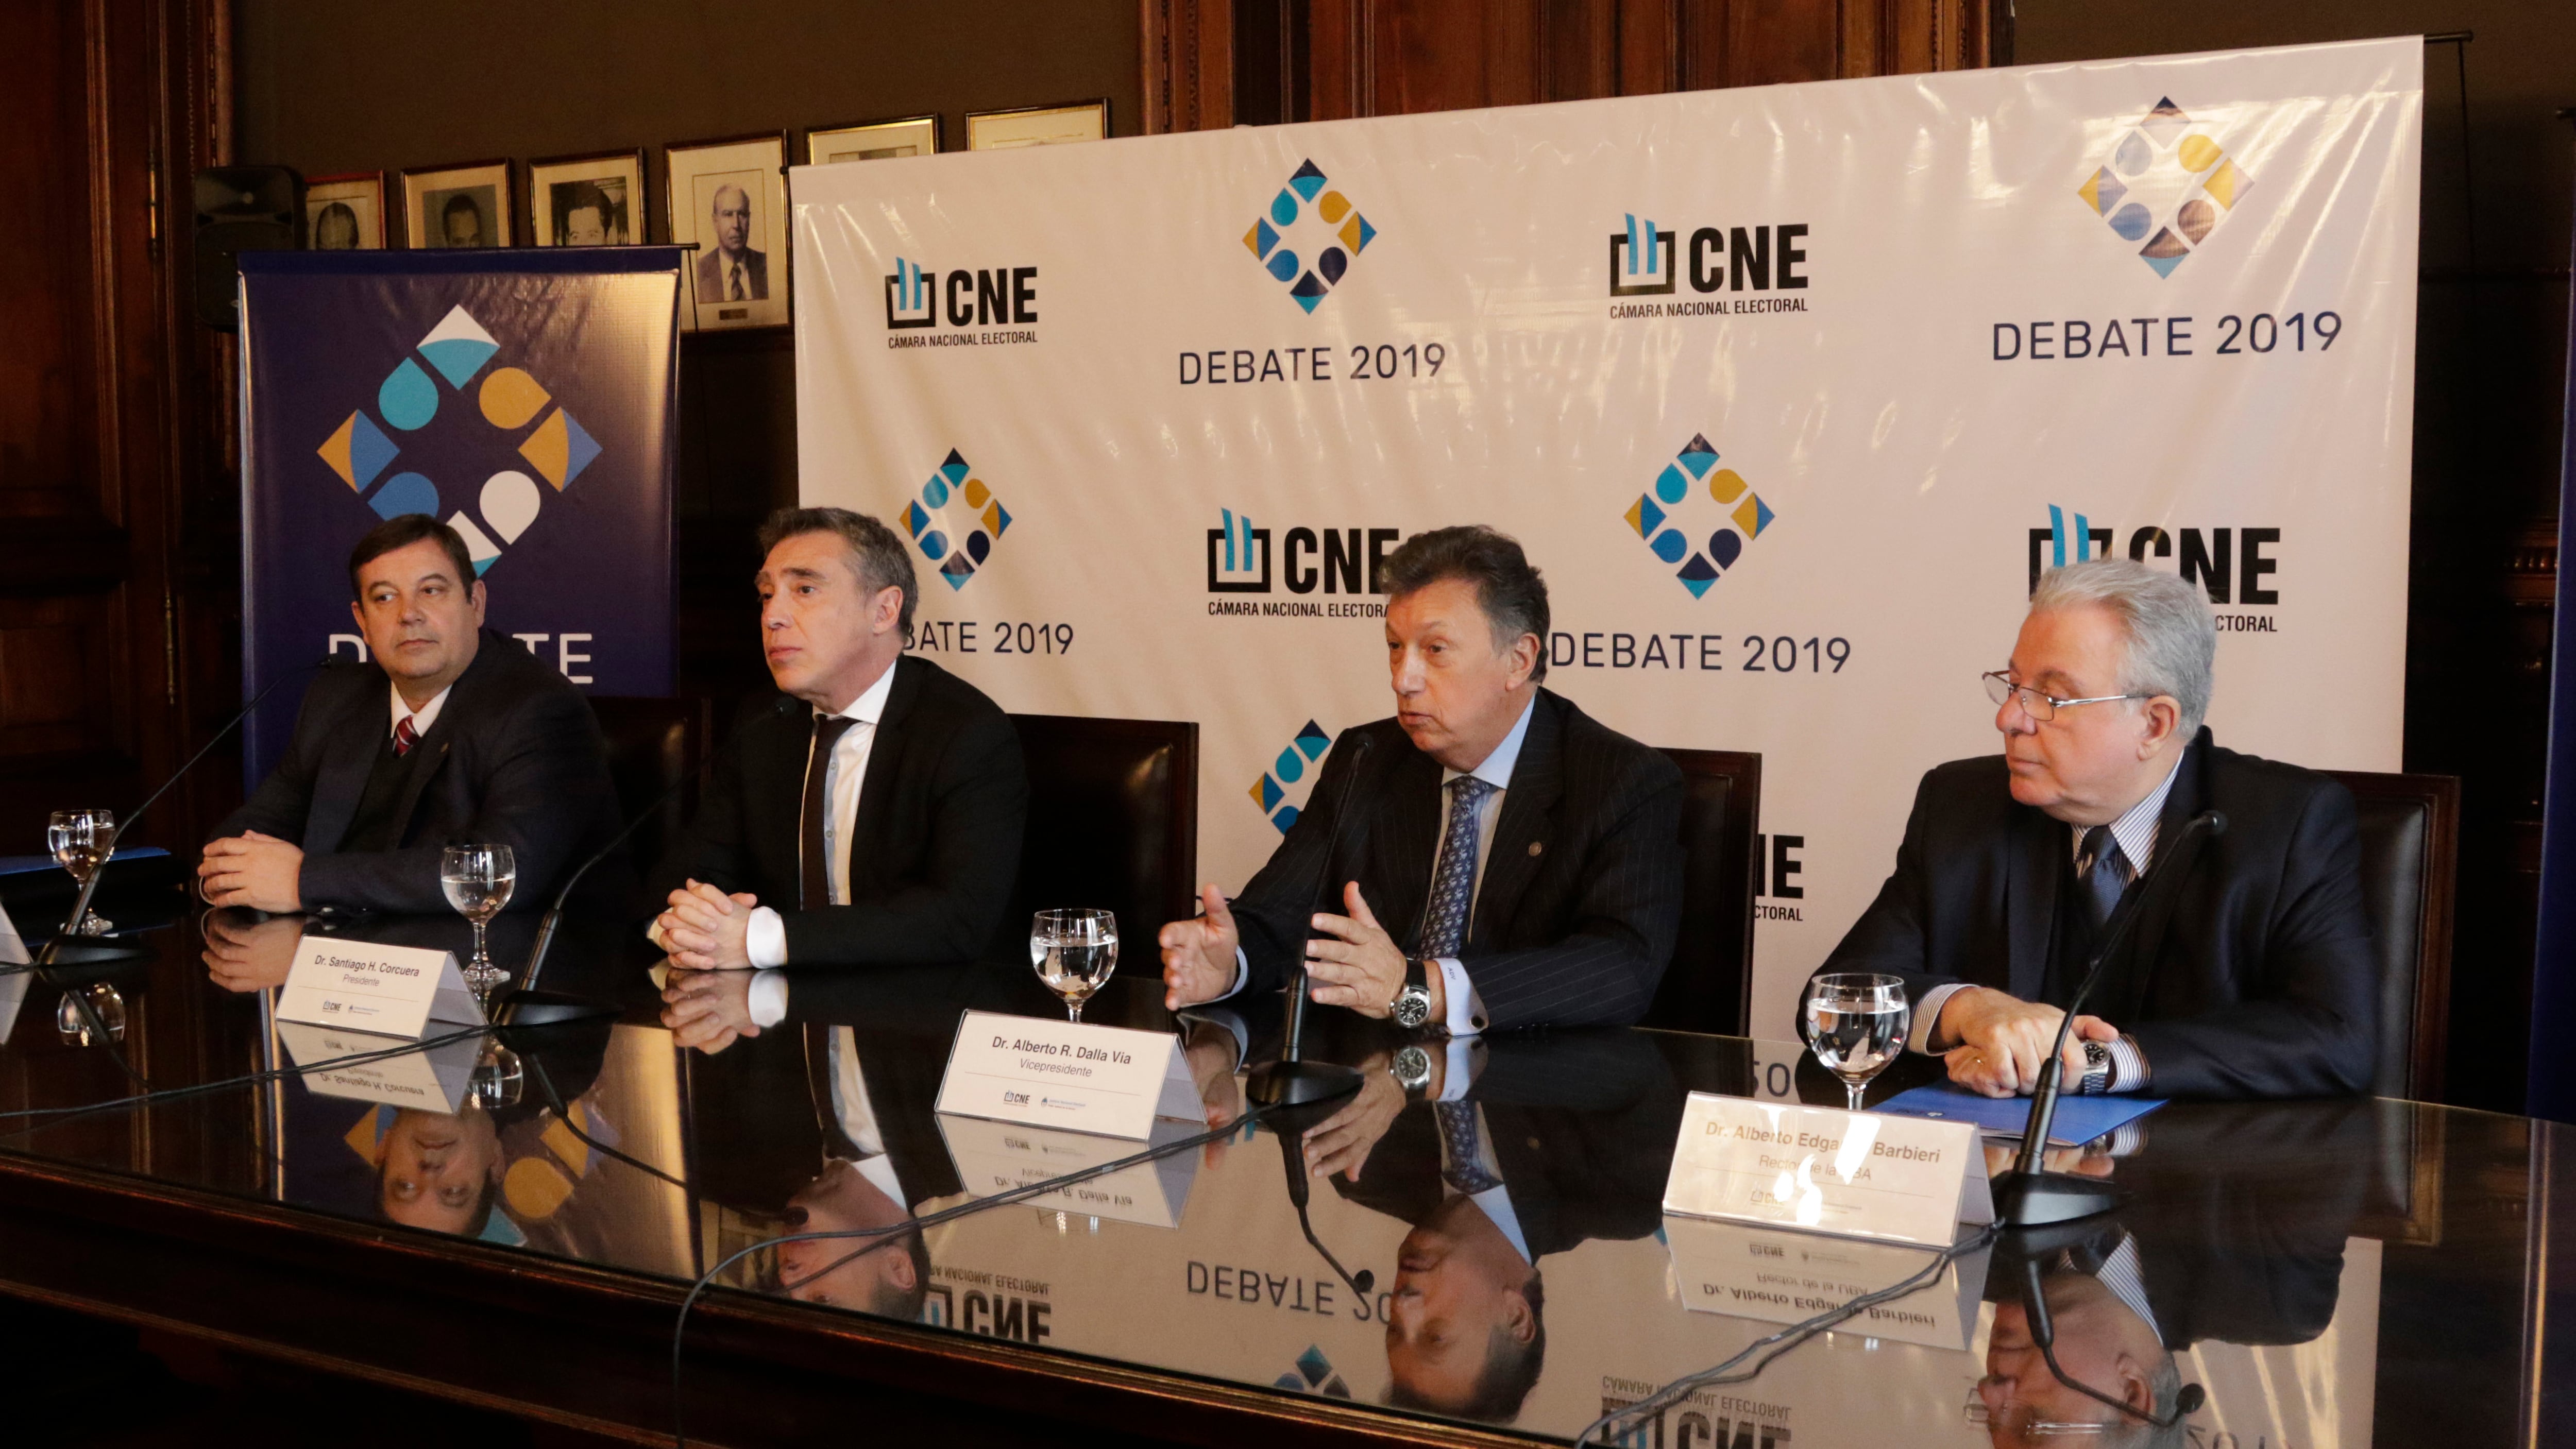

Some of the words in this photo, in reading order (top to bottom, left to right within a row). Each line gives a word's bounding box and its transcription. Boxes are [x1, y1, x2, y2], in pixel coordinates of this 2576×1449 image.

[1690, 224, 1808, 293] CNE
[946, 267, 1038, 327] CNE
[1611, 302, 1663, 319] CÁMARA
[1667, 301, 1730, 316] NACIONAL
[1735, 298, 1808, 314] ELECTORAL
[888, 334, 926, 349] CÁMARA
[929, 334, 978, 347] NACIONAL
[981, 331, 1038, 345] ELECTORAL
[1993, 316, 2193, 360] DEBATE
[2216, 311, 2342, 354] 2019
[1180, 347, 1332, 384] DEBATE
[1350, 343, 1446, 379] 2019
[1284, 526, 1399, 594] CNE
[1208, 599, 1259, 616] CÁMARA
[1263, 602, 1324, 617] NACIONAL
[1328, 603, 1389, 618] ELECTOR
[2215, 615, 2278, 632] CTORAL
[903, 621, 977, 653] BATE
[994, 622, 1074, 654] 2019
[1551, 632, 1722, 670] DEBATE
[1743, 635, 1851, 673] 2019
[1755, 905, 1803, 921] CTORAL
[315, 954, 327, 966] Dr.
[329, 957, 366, 972] Santiago
[368, 961, 377, 971] H.
[379, 962, 420, 977] Corcuera
[342, 974, 380, 987] Presidente
[992, 1036, 1008, 1049] Dr.
[1012, 1038, 1057, 1055] Alberto
[1060, 1045, 1072, 1057] R.
[1076, 1047, 1108, 1062] Dalla
[1112, 1051, 1131, 1064] Via
[1020, 1058, 1093, 1077] Vicepresidente
[1014, 1093, 1030, 1104] CNE
[1705, 1121, 1728, 1137] Dr.
[1733, 1124, 1793, 1146] Alberto
[1798, 1132, 1839, 1153] Edga
[1873, 1141, 1941, 1163] Barbieri
[1825, 1163, 1837, 1175] la
[1855, 1166, 1872, 1181] BA
